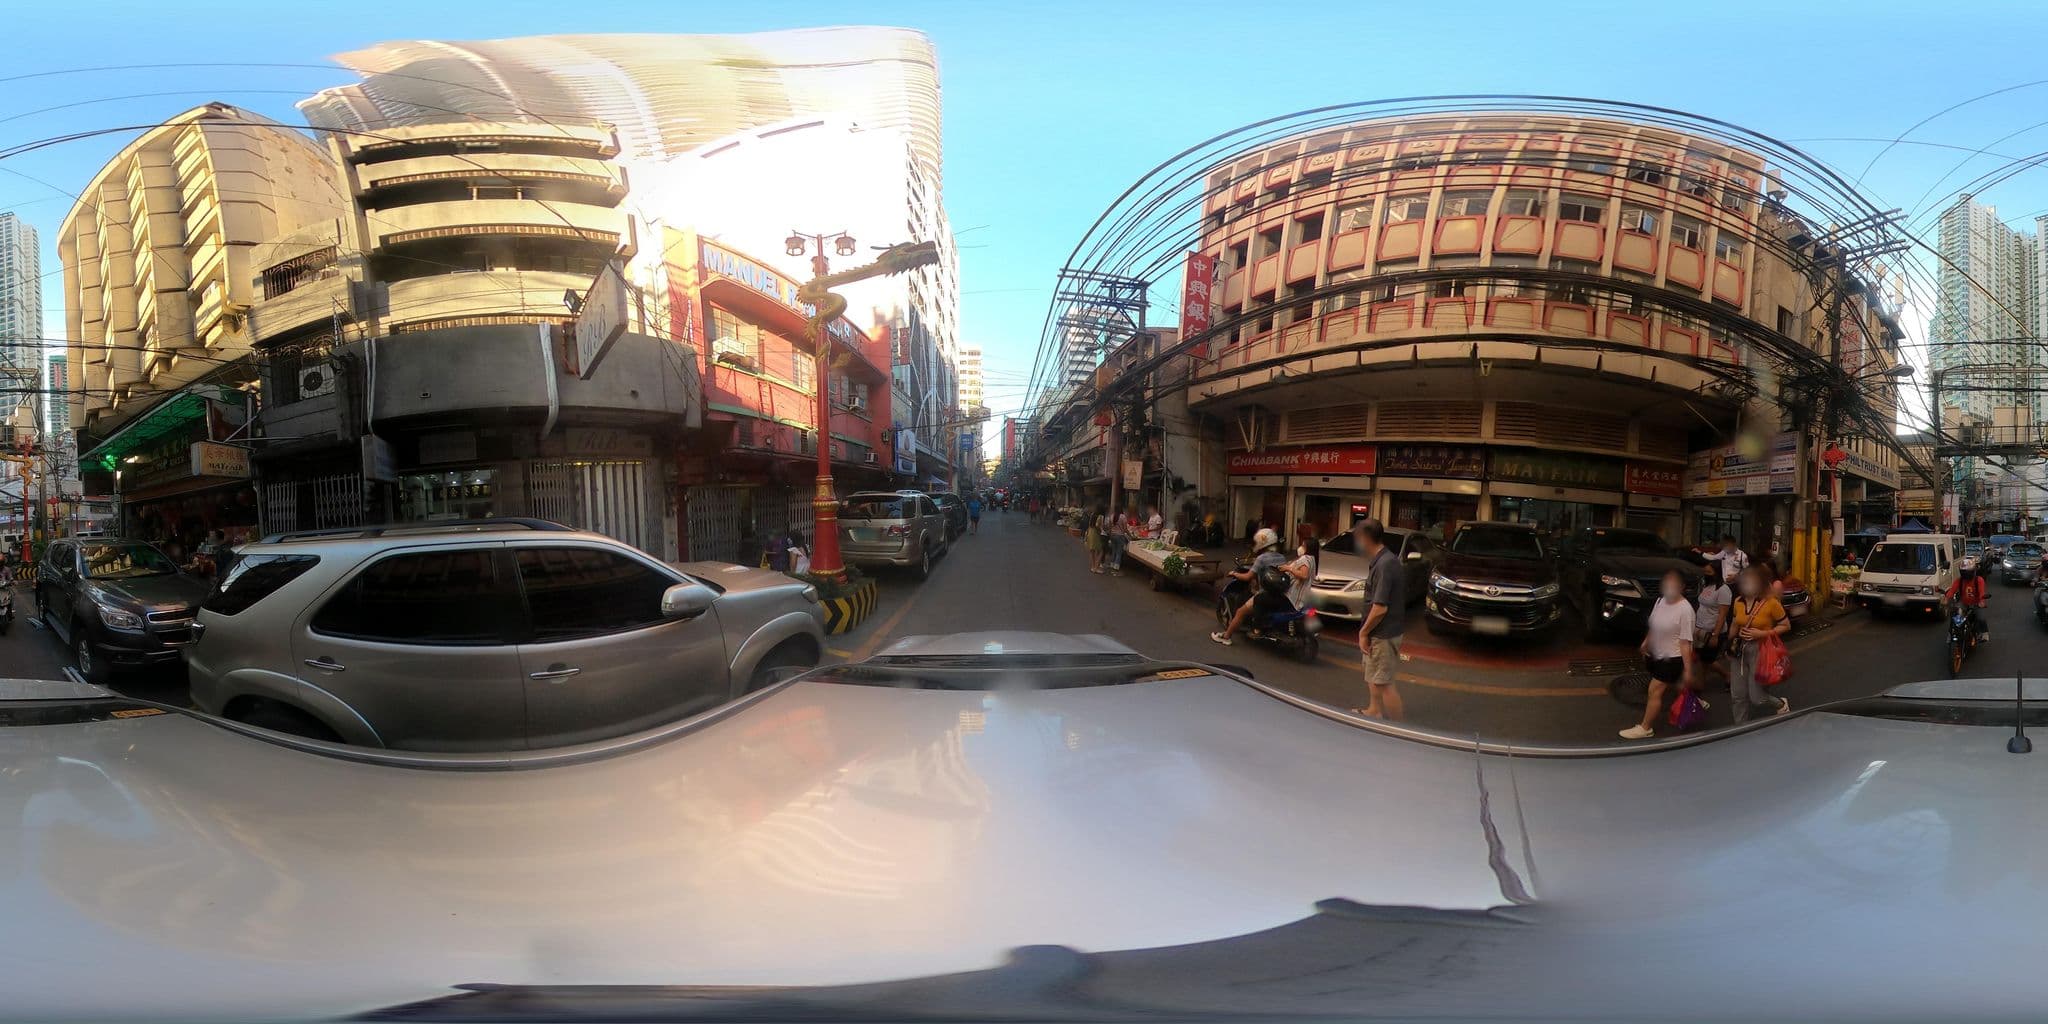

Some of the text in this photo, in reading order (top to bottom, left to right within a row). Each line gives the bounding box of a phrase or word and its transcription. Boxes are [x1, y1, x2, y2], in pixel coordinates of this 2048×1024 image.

[703, 243, 781, 302] MANUEL
[1231, 454, 1299, 467] CHINABANK
[1502, 463, 1599, 482] MAYFAIR
